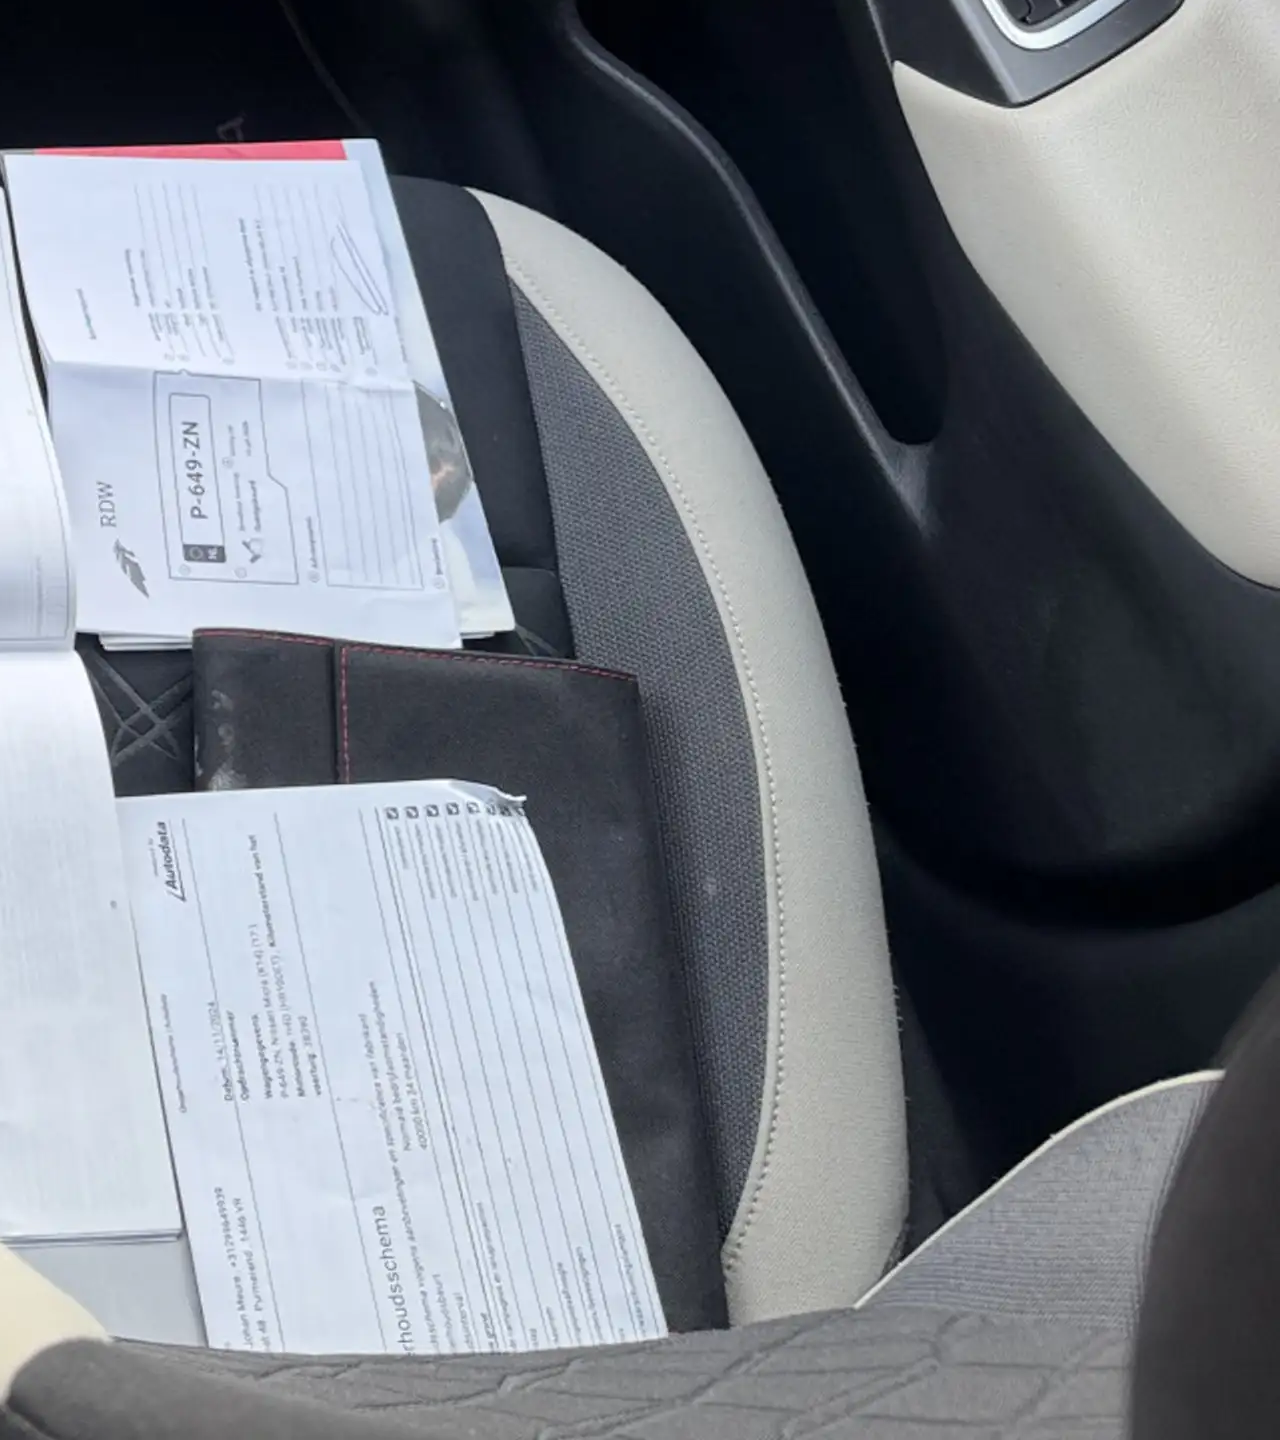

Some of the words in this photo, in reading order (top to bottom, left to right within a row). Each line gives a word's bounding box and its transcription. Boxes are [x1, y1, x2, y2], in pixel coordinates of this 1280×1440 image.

[96, 480, 118, 529] RDW
[181, 421, 209, 520] P-649-ZN
[156, 821, 178, 890] Autodata
